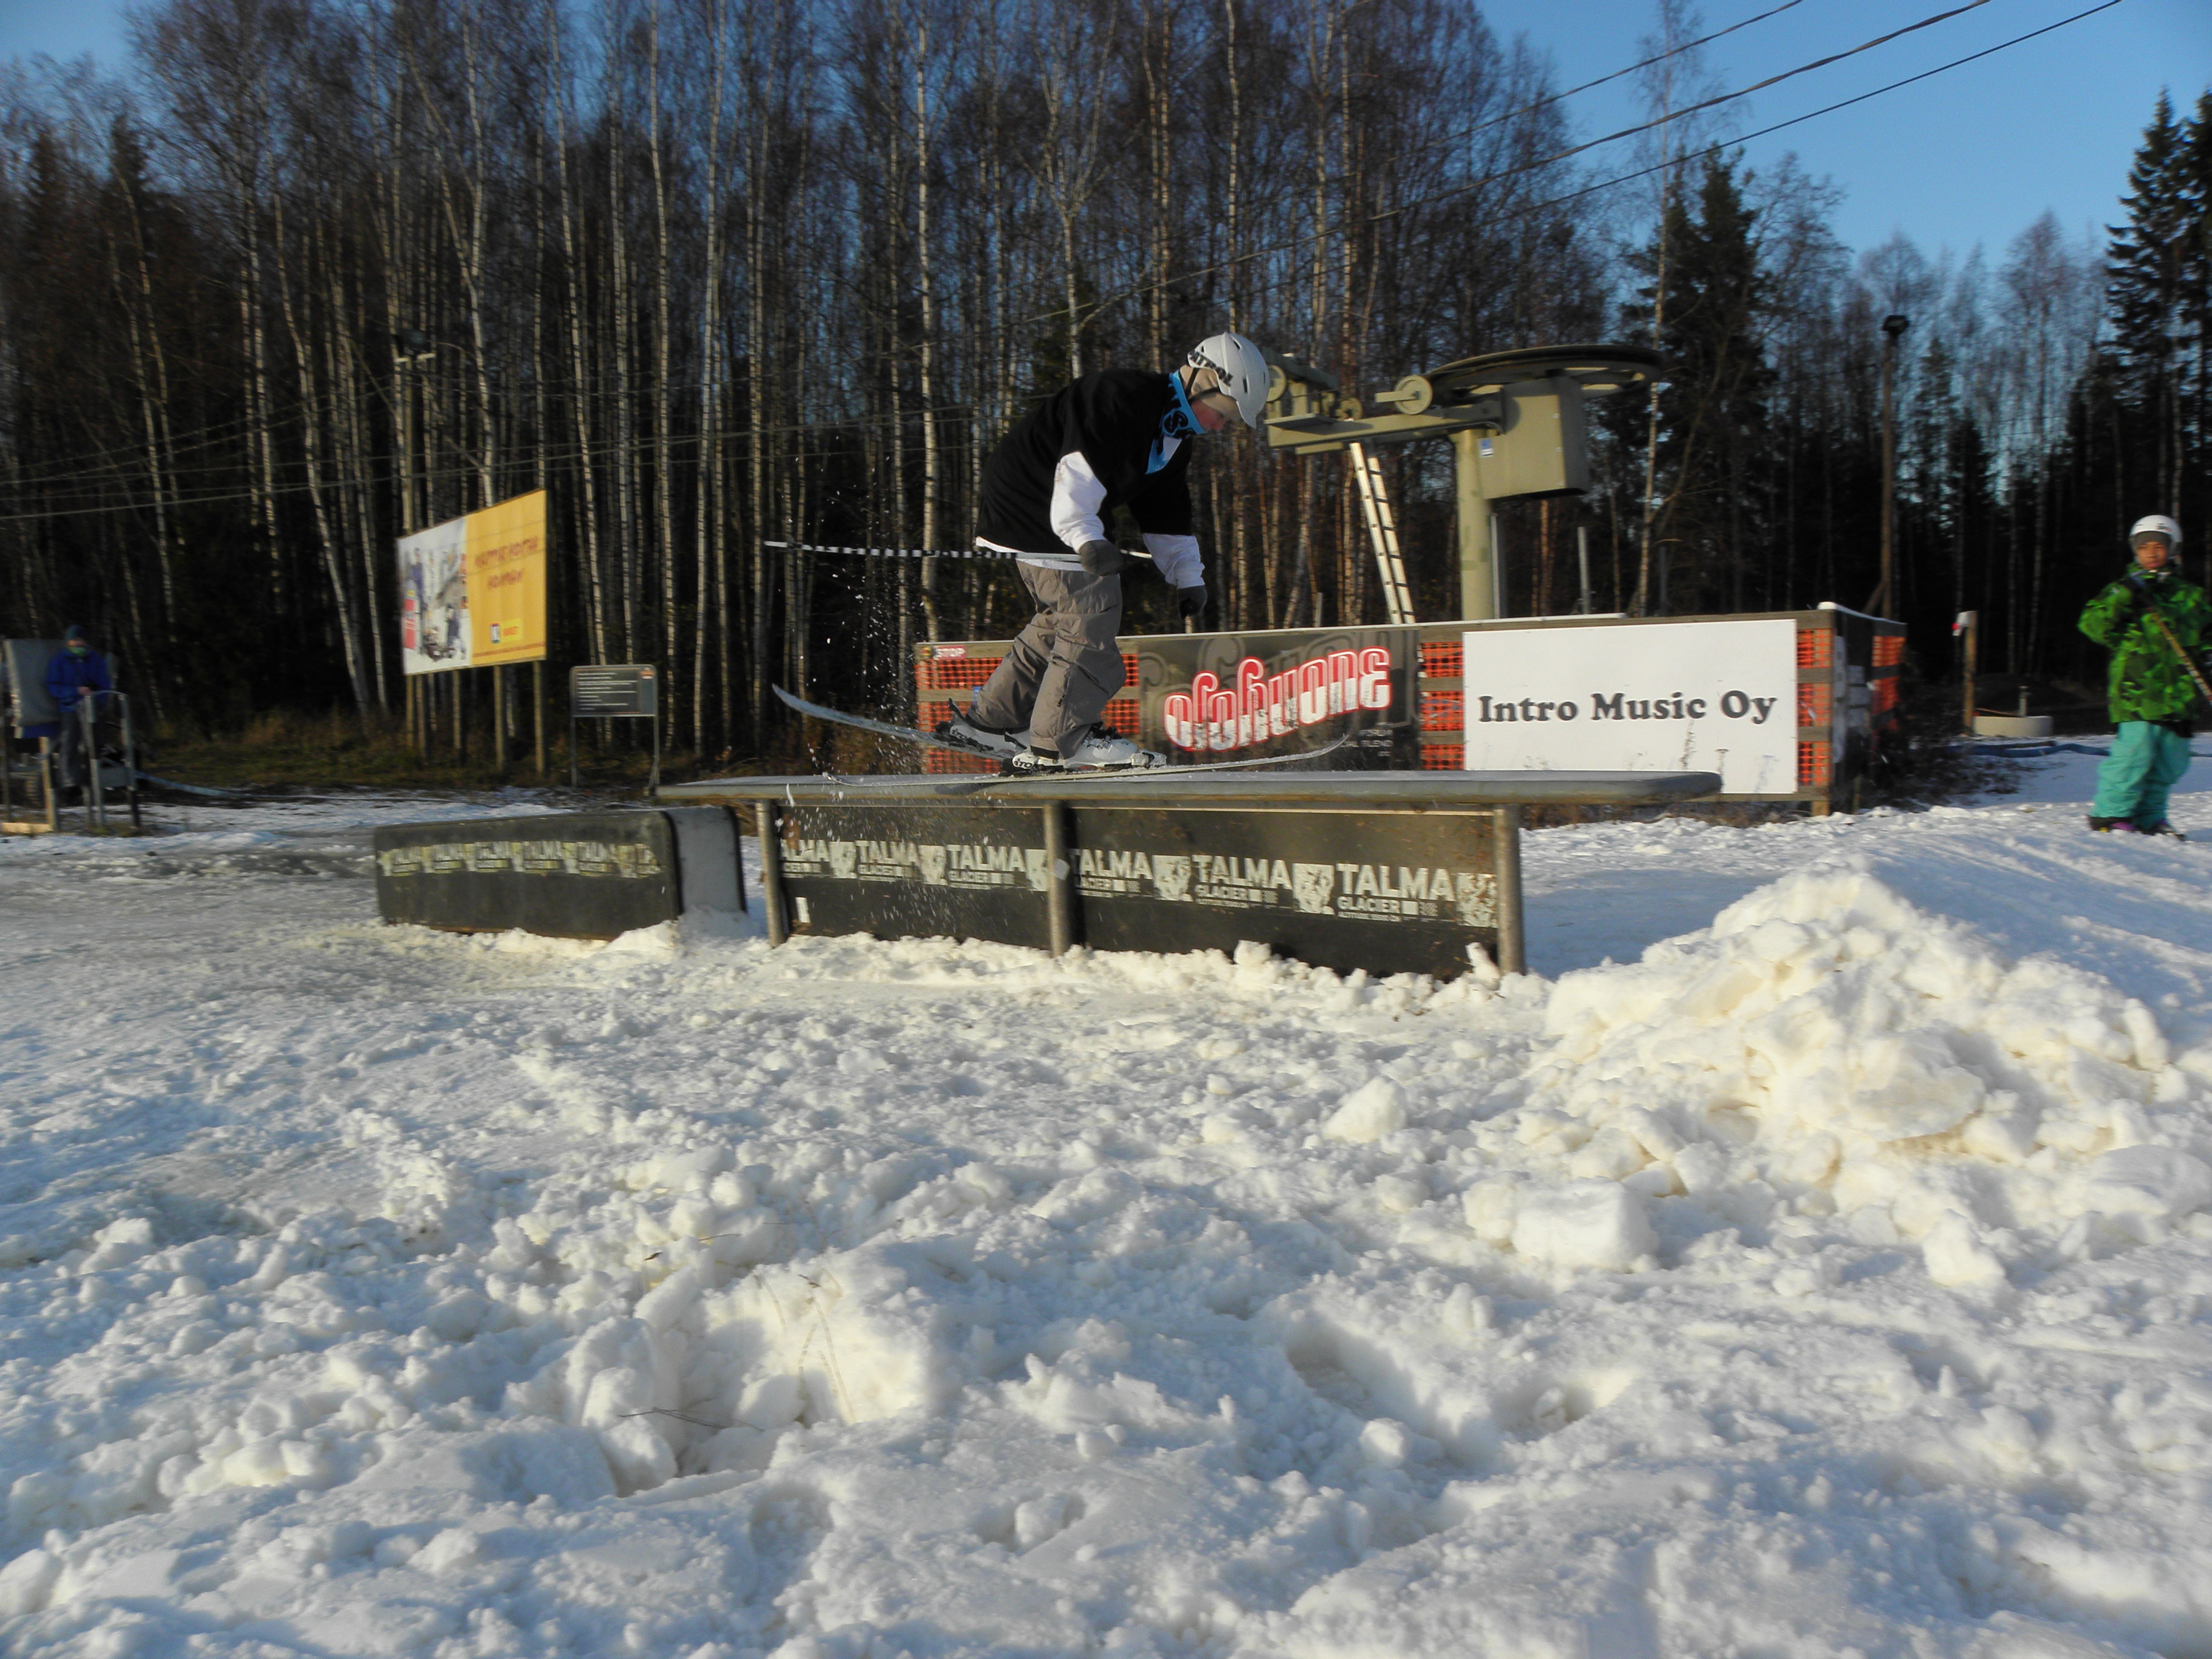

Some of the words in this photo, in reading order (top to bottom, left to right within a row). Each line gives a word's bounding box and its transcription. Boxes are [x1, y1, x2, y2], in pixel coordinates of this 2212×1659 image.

[1477, 695, 1578, 722] Intro
[1590, 691, 1707, 721] Music
[1720, 690, 1778, 725] Oy
[780, 839, 830, 862] ALMA
[855, 840, 920, 866] TALMA
[947, 844, 1027, 872] TALMA
[1192, 855, 1293, 890] TALMA
[1336, 863, 1456, 901] TALMA
[1337, 895, 1401, 914] GLACIER
